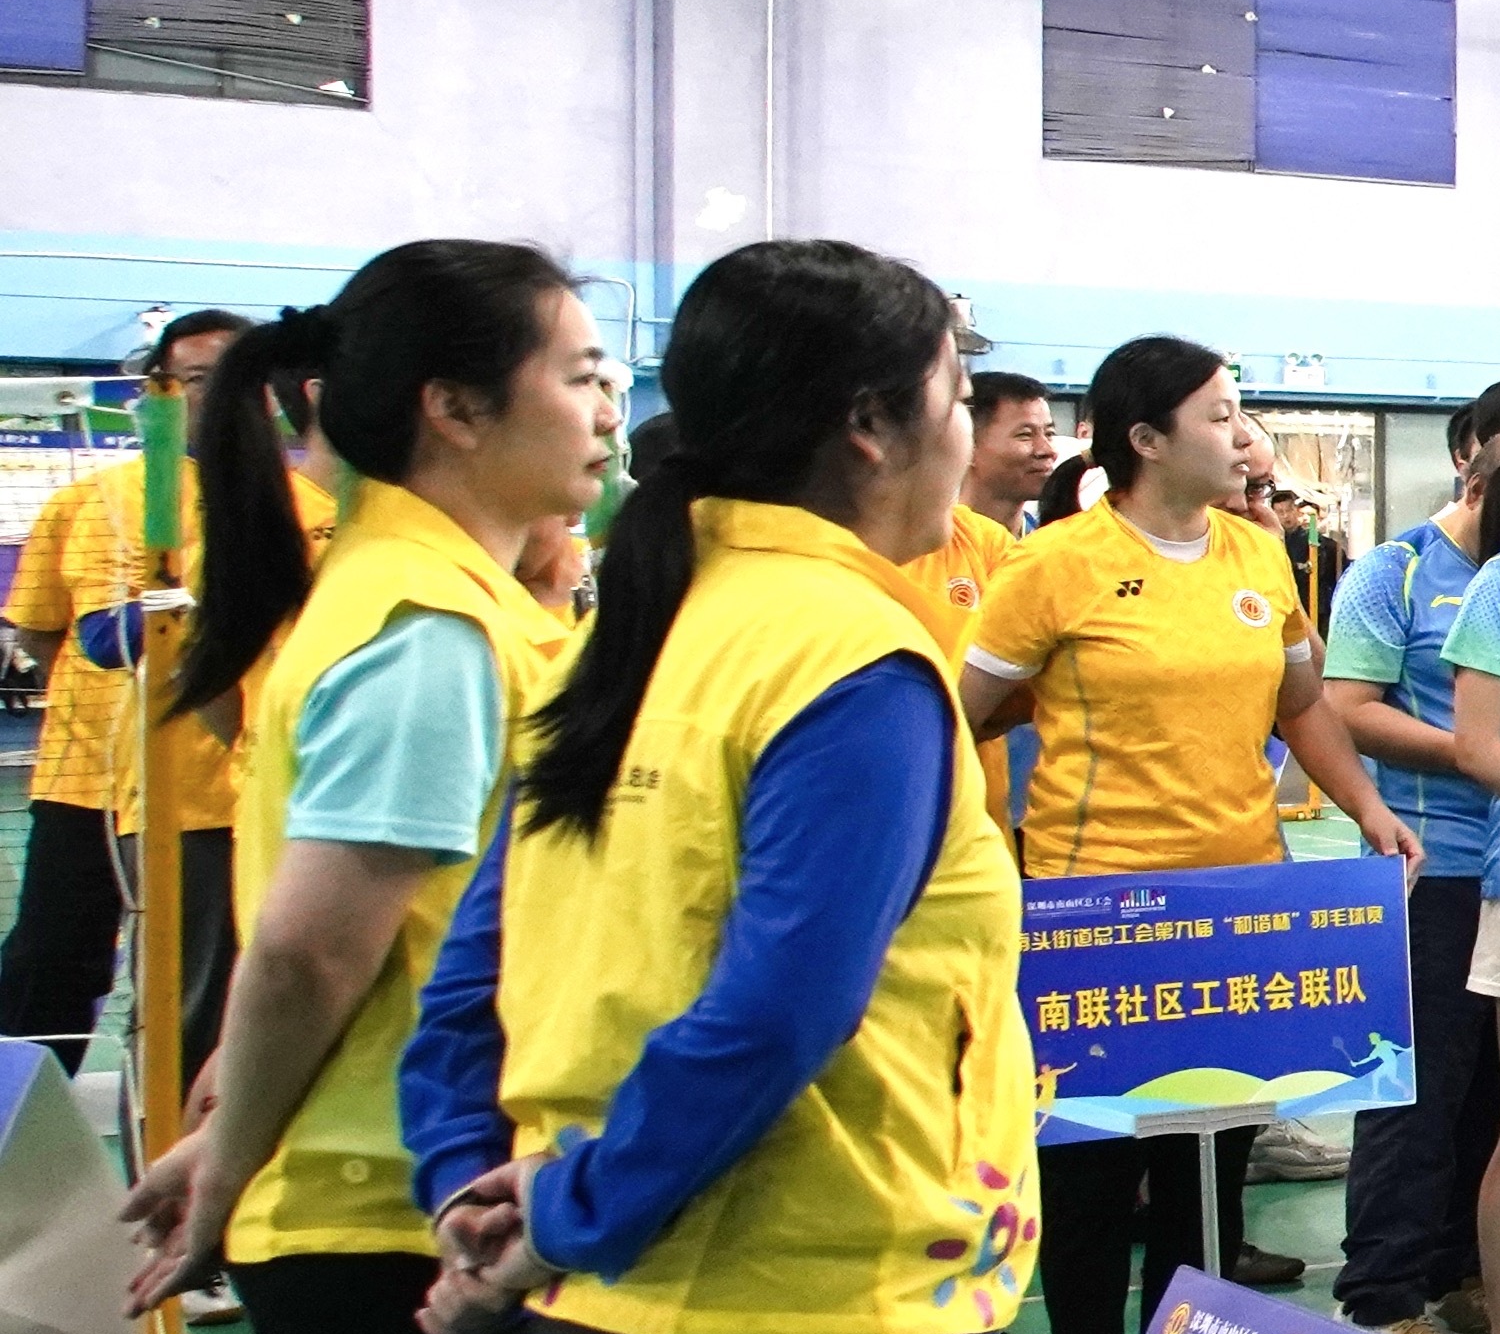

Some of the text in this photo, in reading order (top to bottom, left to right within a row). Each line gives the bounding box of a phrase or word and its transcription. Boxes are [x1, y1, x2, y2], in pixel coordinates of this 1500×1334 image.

[1036, 965, 1367, 1033] 南联社区工联会联队
